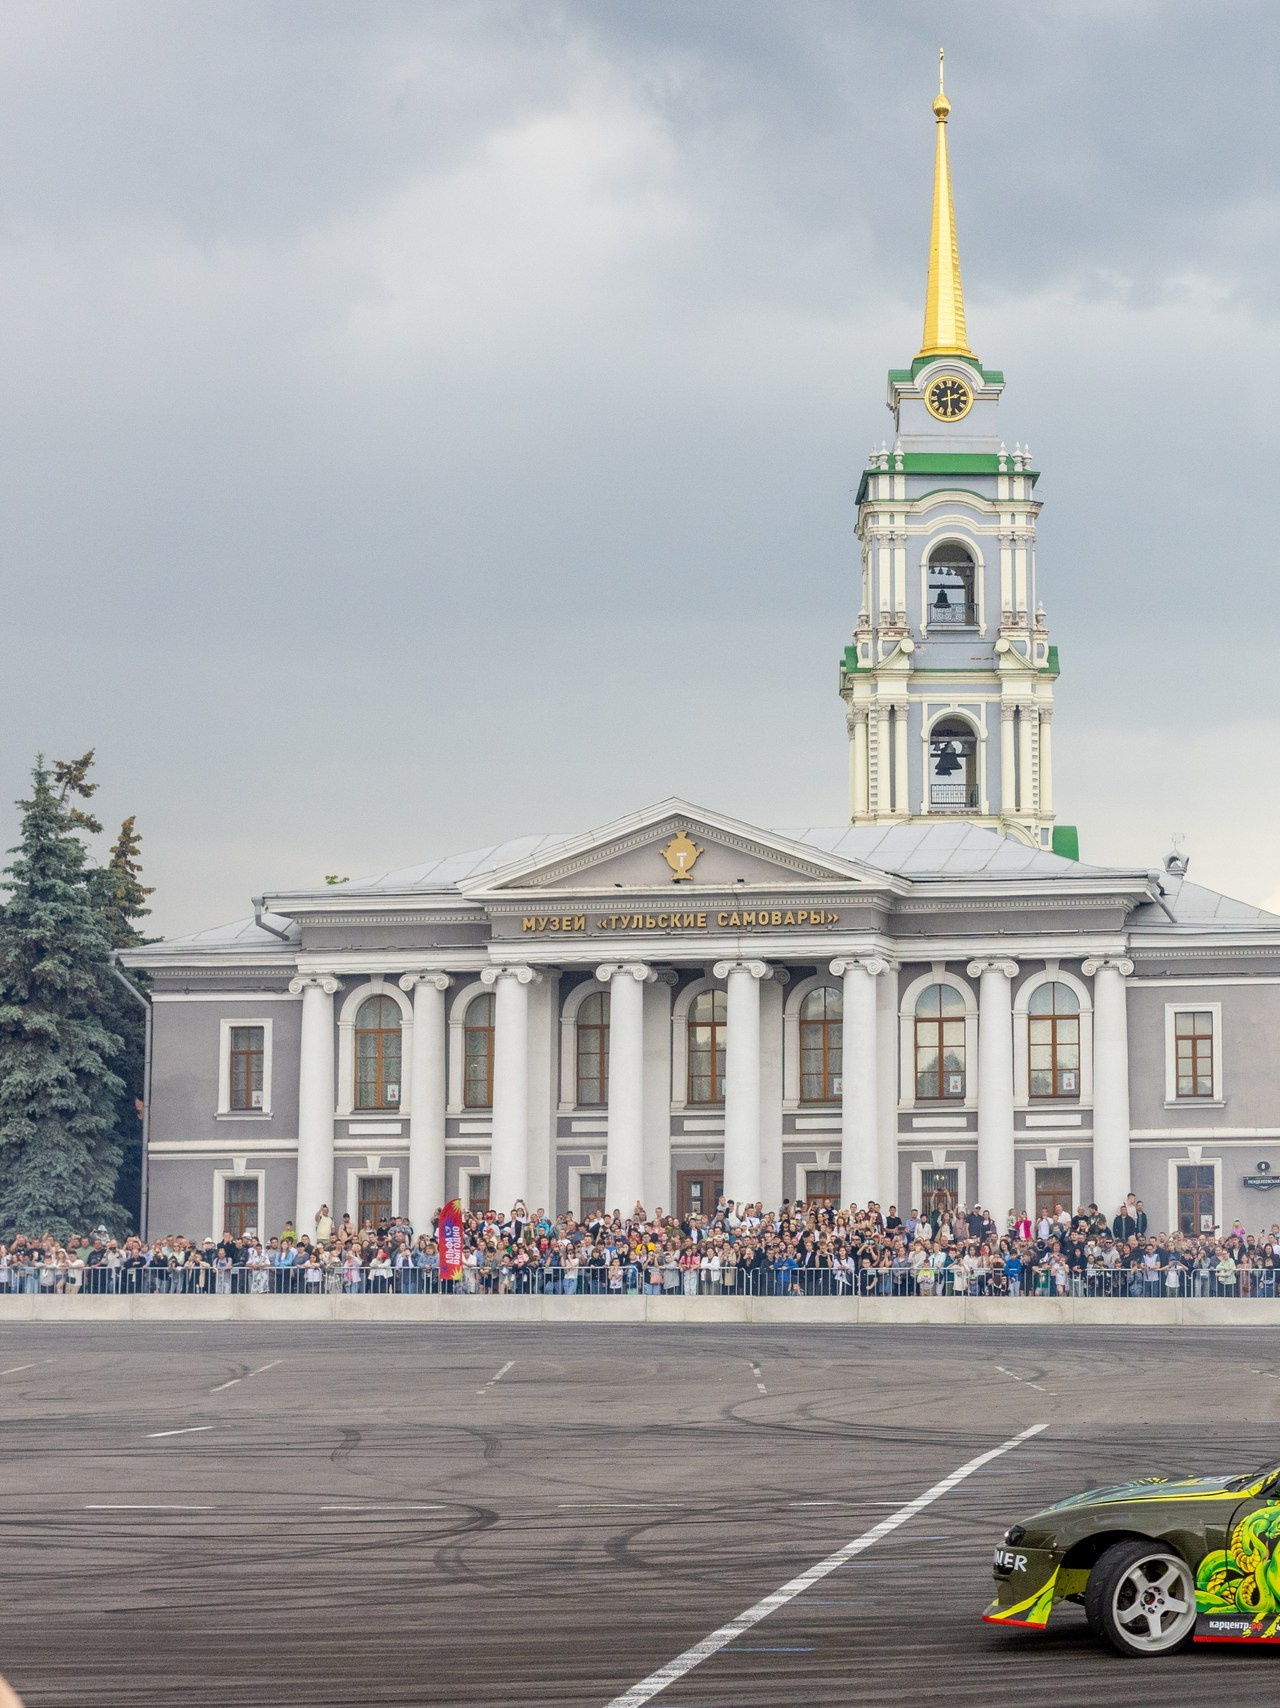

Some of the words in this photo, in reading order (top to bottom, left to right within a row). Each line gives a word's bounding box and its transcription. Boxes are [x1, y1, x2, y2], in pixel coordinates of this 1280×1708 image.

[522, 913, 586, 931] МУЗЕЙ
[596, 911, 707, 930] «ТУЛЬСКИЕ
[717, 909, 839, 927] САМОВАРЫ»
[445, 1237, 454, 1264] АЛЬФА
[452, 1226, 461, 1265] ВЫГОДНО
[1209, 1620, 1264, 1632] карцентр.рф
